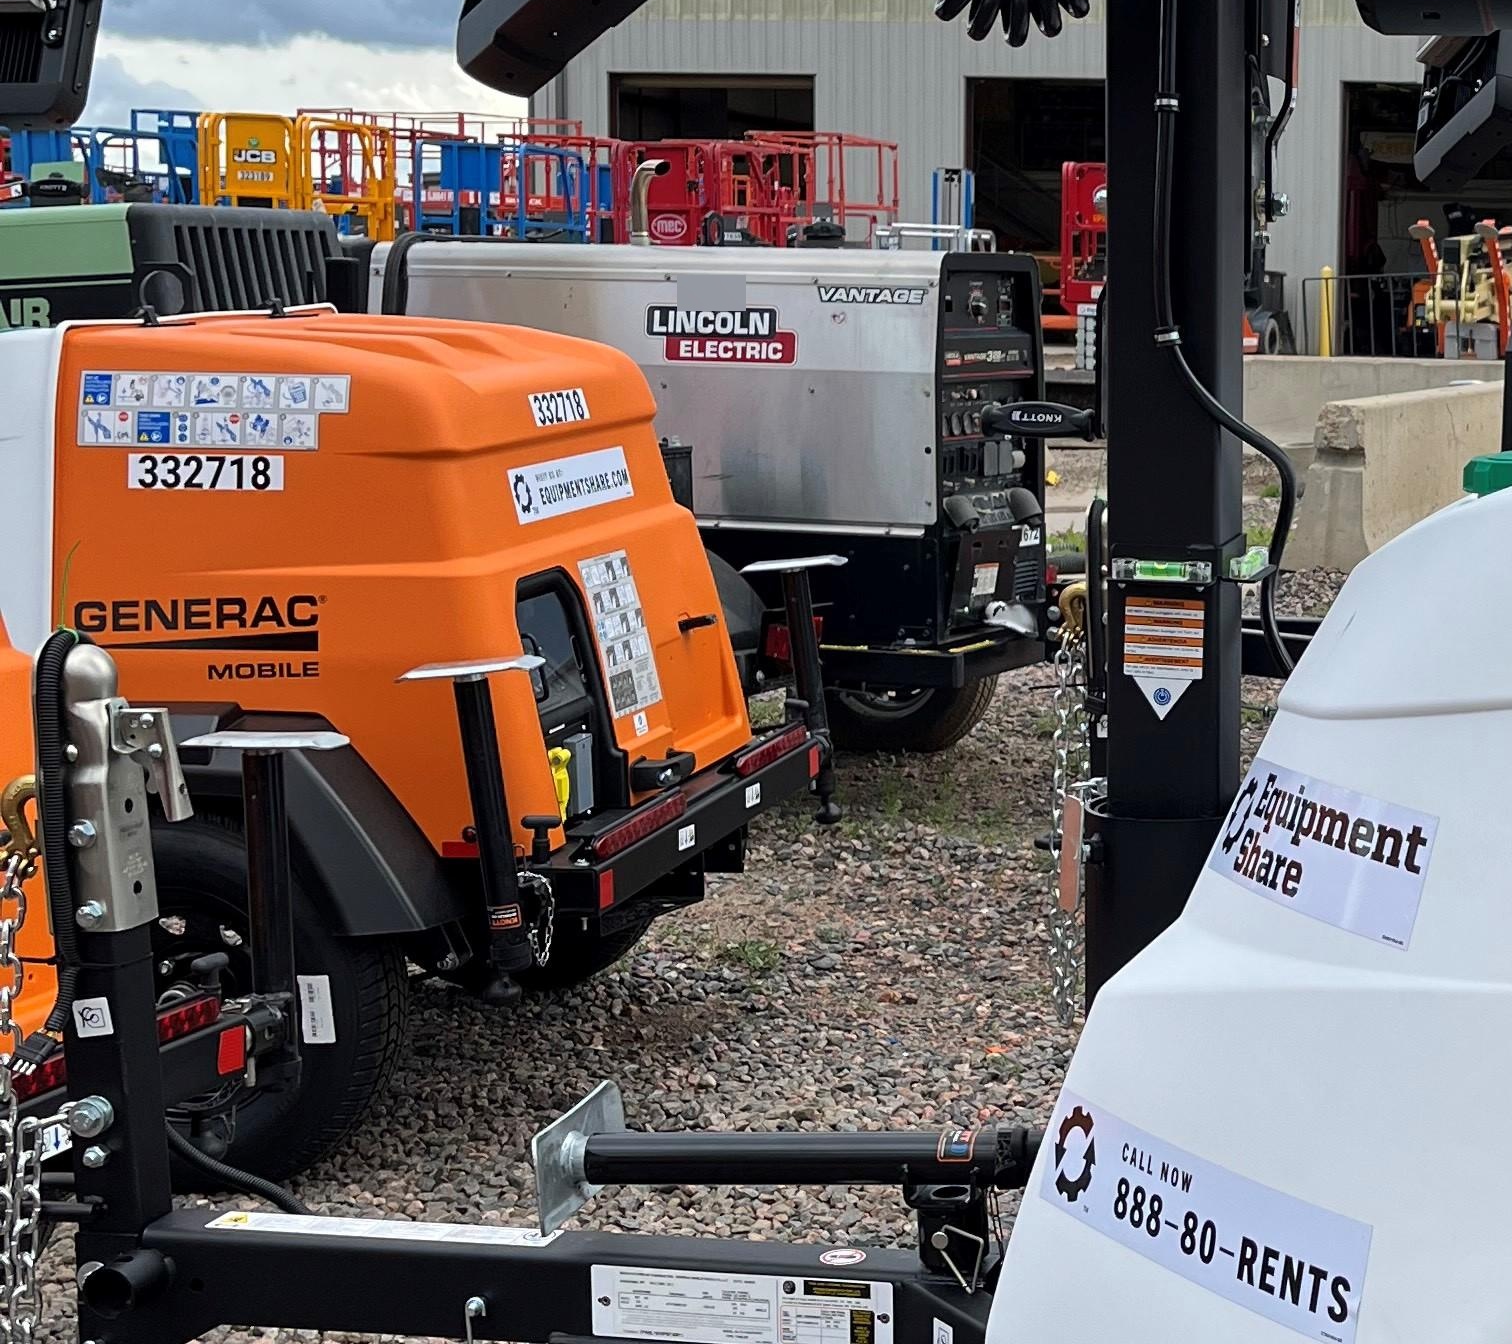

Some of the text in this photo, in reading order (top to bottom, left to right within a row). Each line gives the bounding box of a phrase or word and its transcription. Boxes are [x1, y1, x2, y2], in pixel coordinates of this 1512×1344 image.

[233, 149, 276, 163] JCB
[655, 217, 686, 235] mec
[818, 286, 926, 304] VANTAGE
[652, 309, 770, 335] LINCOLN
[679, 340, 783, 360] ELECTRIC
[533, 391, 583, 425] 332718
[1021, 413, 1063, 423] KNOTT
[138, 455, 271, 490] 332718
[538, 468, 629, 506] EQUIPMENTSHARE.COM
[206, 661, 320, 680] MOBILE
[1256, 772, 1429, 875] Equipment
[1232, 834, 1304, 899] Share
[1121, 1142, 1193, 1194] CALL NOW
[1112, 1176, 1352, 1324] 888-80-RENTS
